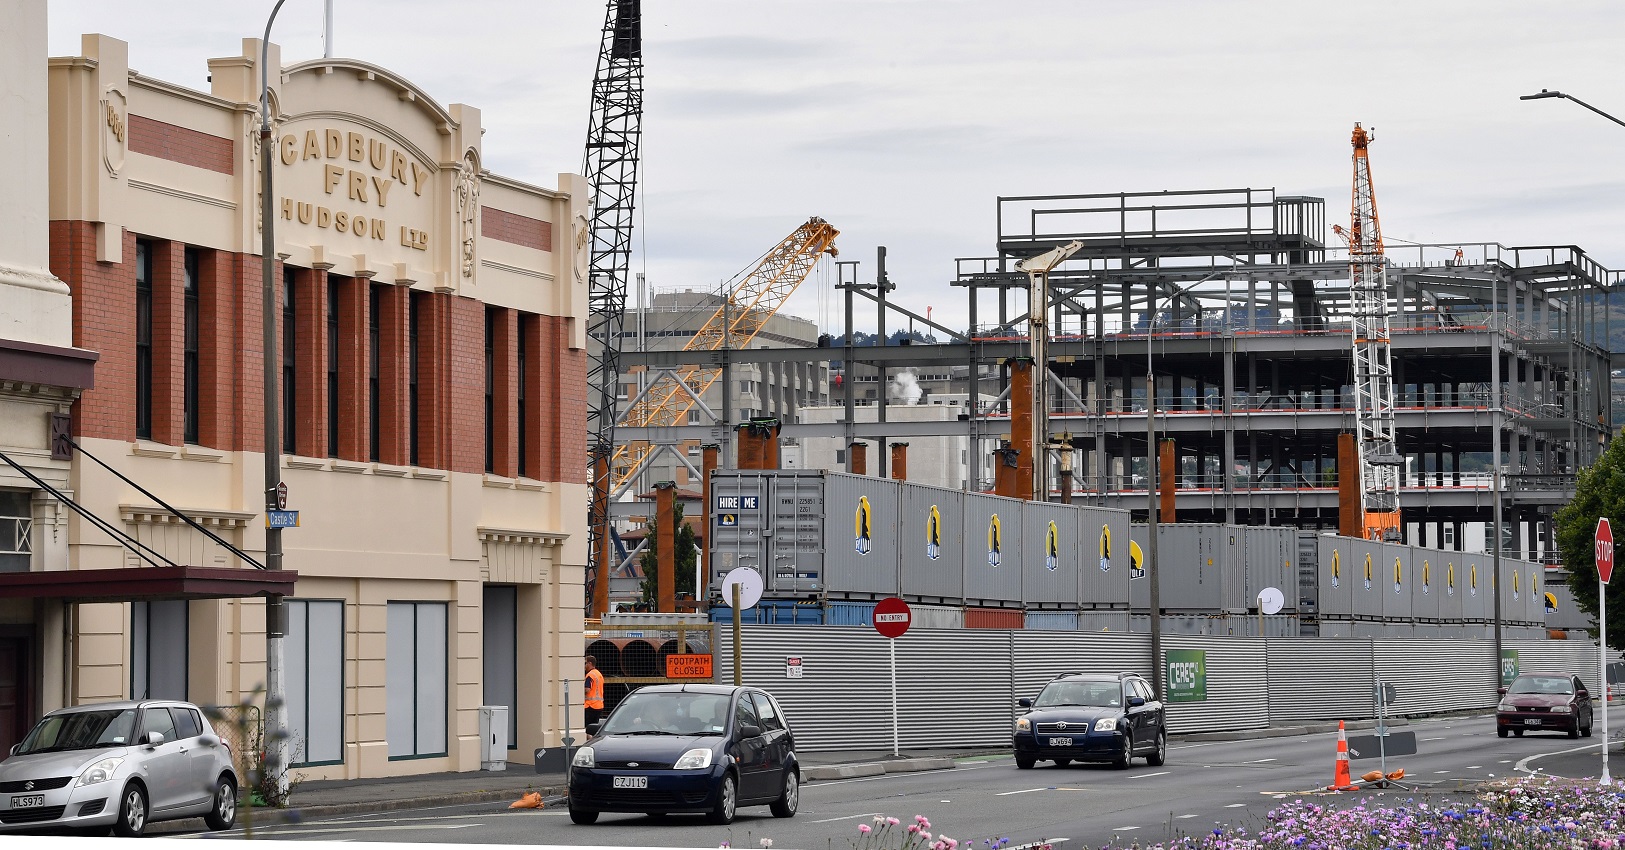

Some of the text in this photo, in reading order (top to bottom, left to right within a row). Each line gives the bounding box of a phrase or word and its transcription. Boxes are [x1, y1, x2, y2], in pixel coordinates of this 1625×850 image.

[281, 128, 429, 196] CADBURY
[325, 163, 393, 207] FRY
[281, 196, 429, 251] HUDSON LTD
[719, 497, 756, 509] HIRE ME
[271, 512, 296, 525] Castle St
[1597, 539, 1612, 562] STOP
[1131, 569, 1143, 578] OLF
[888, 614, 904, 622] ENTRY
[669, 657, 710, 666] FOOTPATH
[674, 666, 705, 675] CLOSED
[1170, 662, 1195, 689] CERES
[615, 778, 646, 787] CZJ119
[13, 797, 43, 807] HLS973
